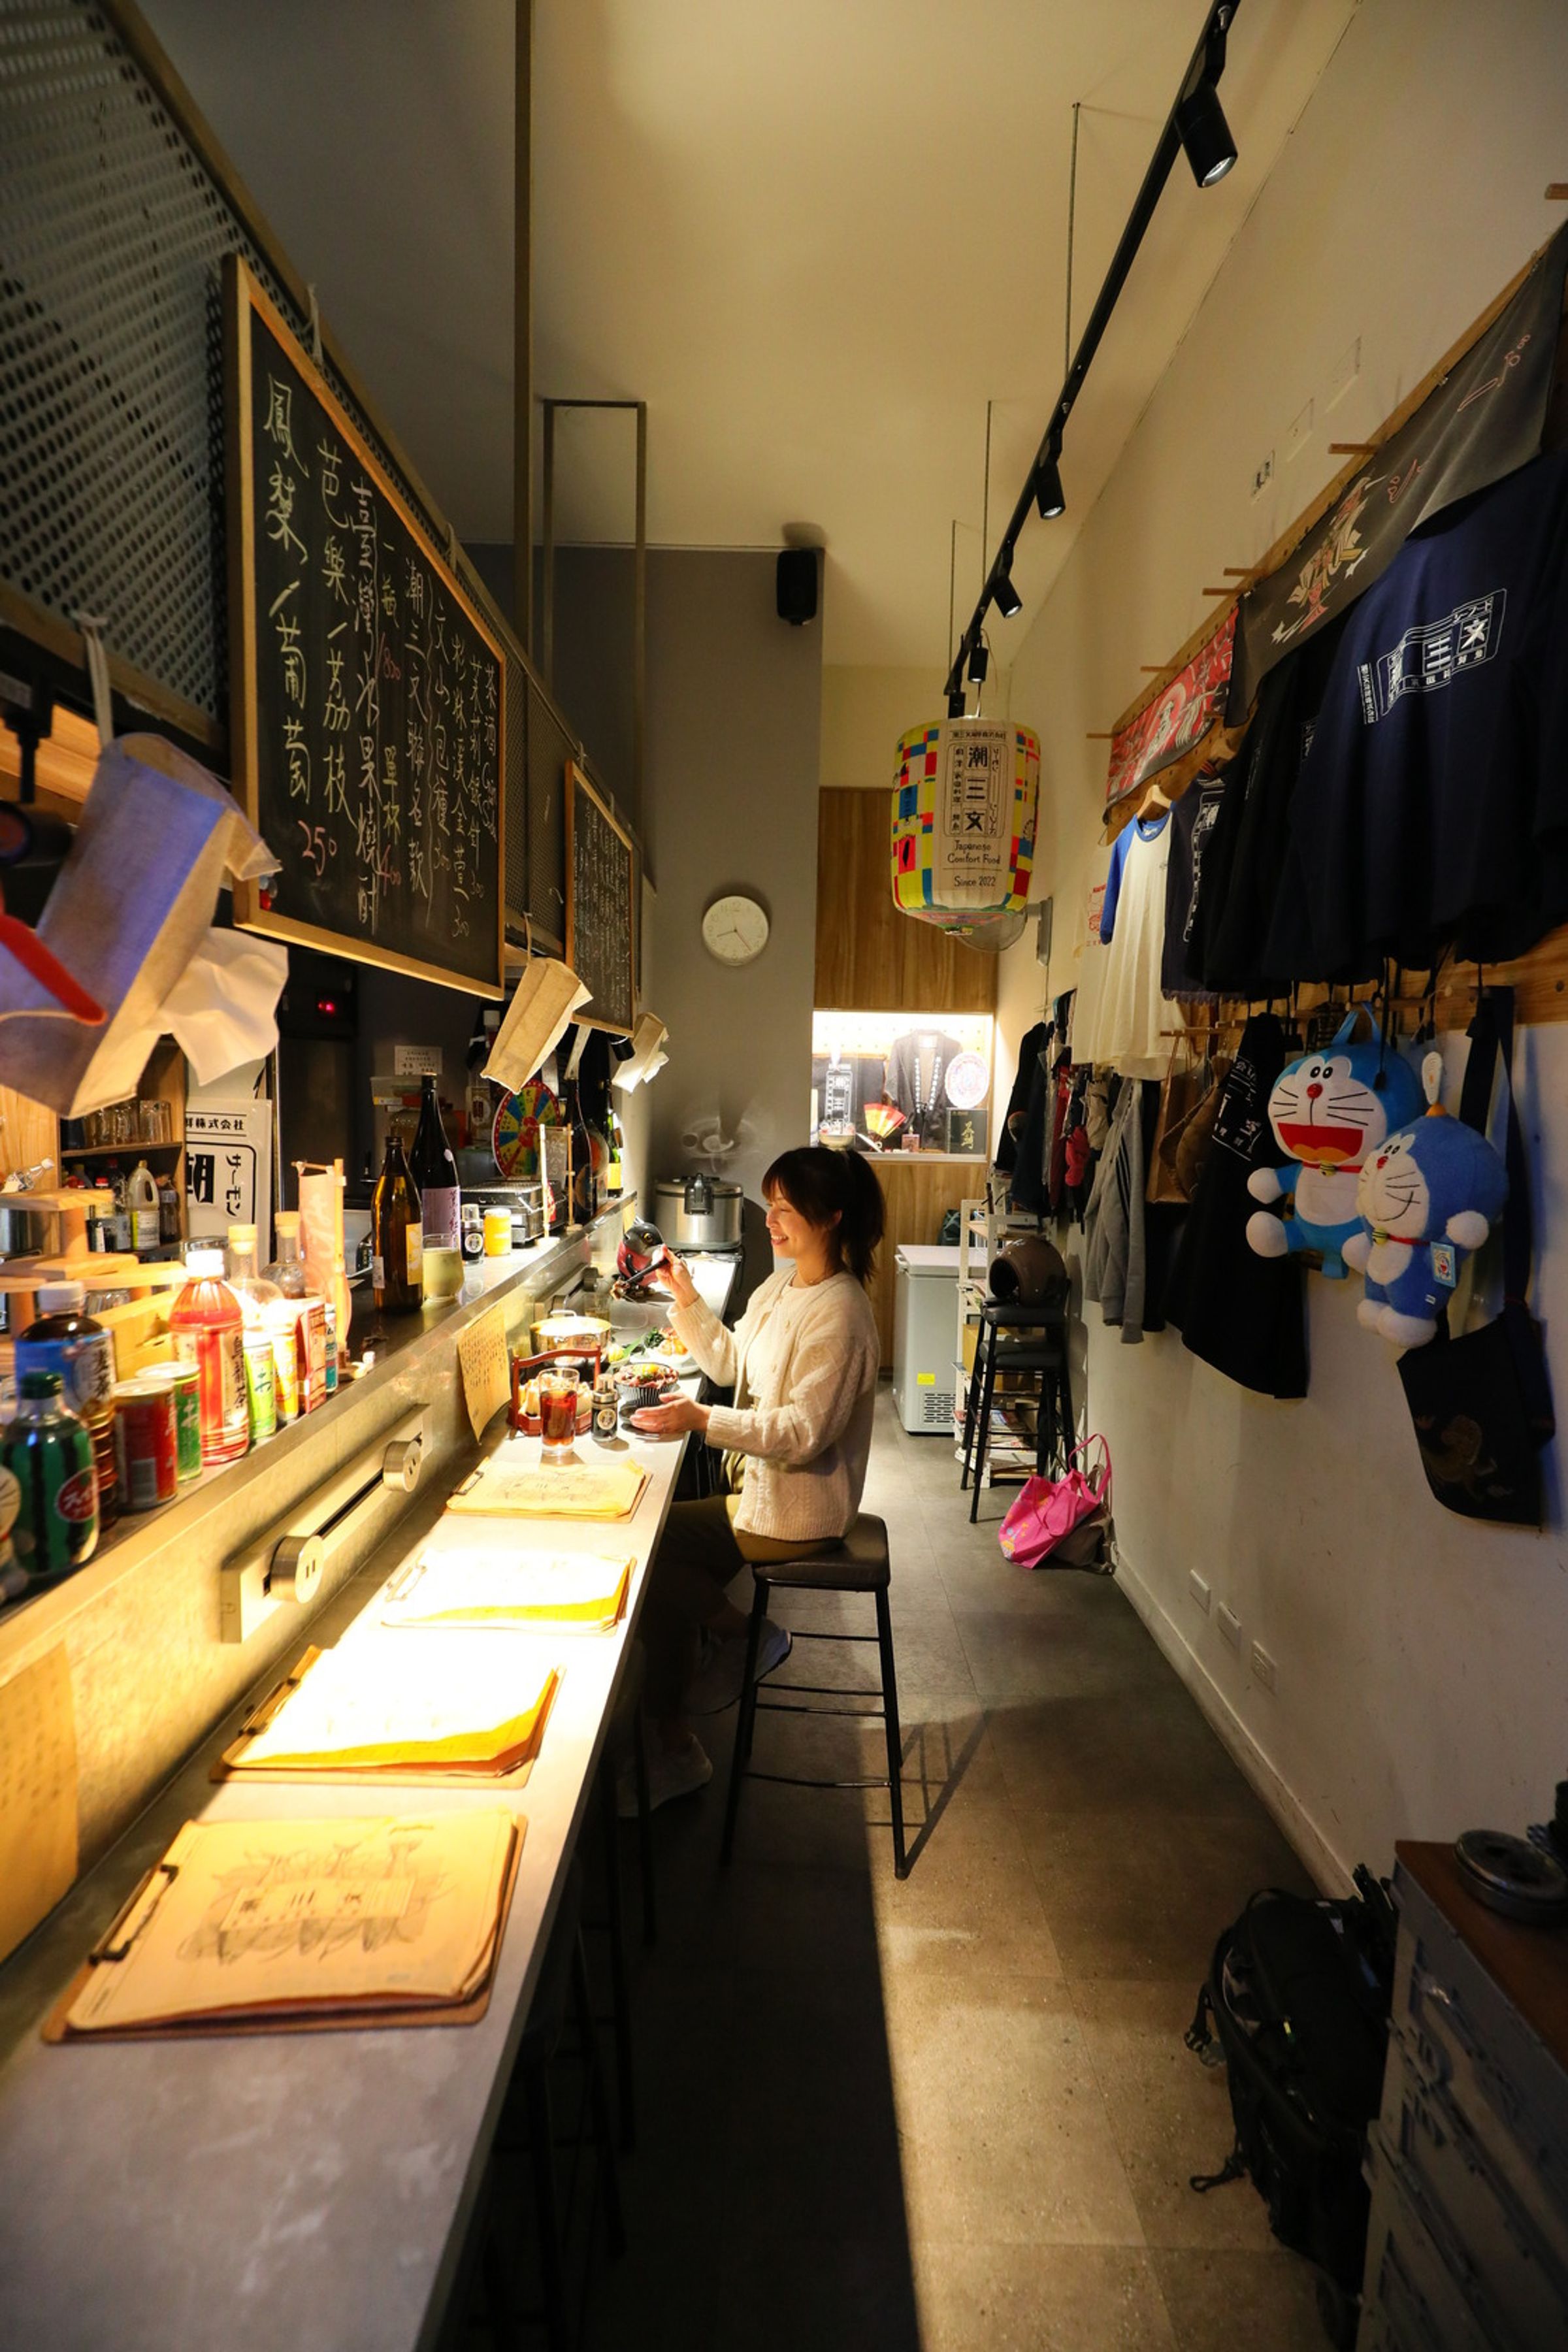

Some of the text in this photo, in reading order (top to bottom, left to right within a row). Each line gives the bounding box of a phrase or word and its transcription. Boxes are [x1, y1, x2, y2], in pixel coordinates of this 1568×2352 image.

[964, 747, 988, 832] 潮三文
[297, 821, 337, 876] 250
[947, 853, 1001, 864] Comfort Food
[954, 840, 991, 854] Japanese
[954, 875, 977, 887] Since
[225, 1154, 242, 1217] サーモン
